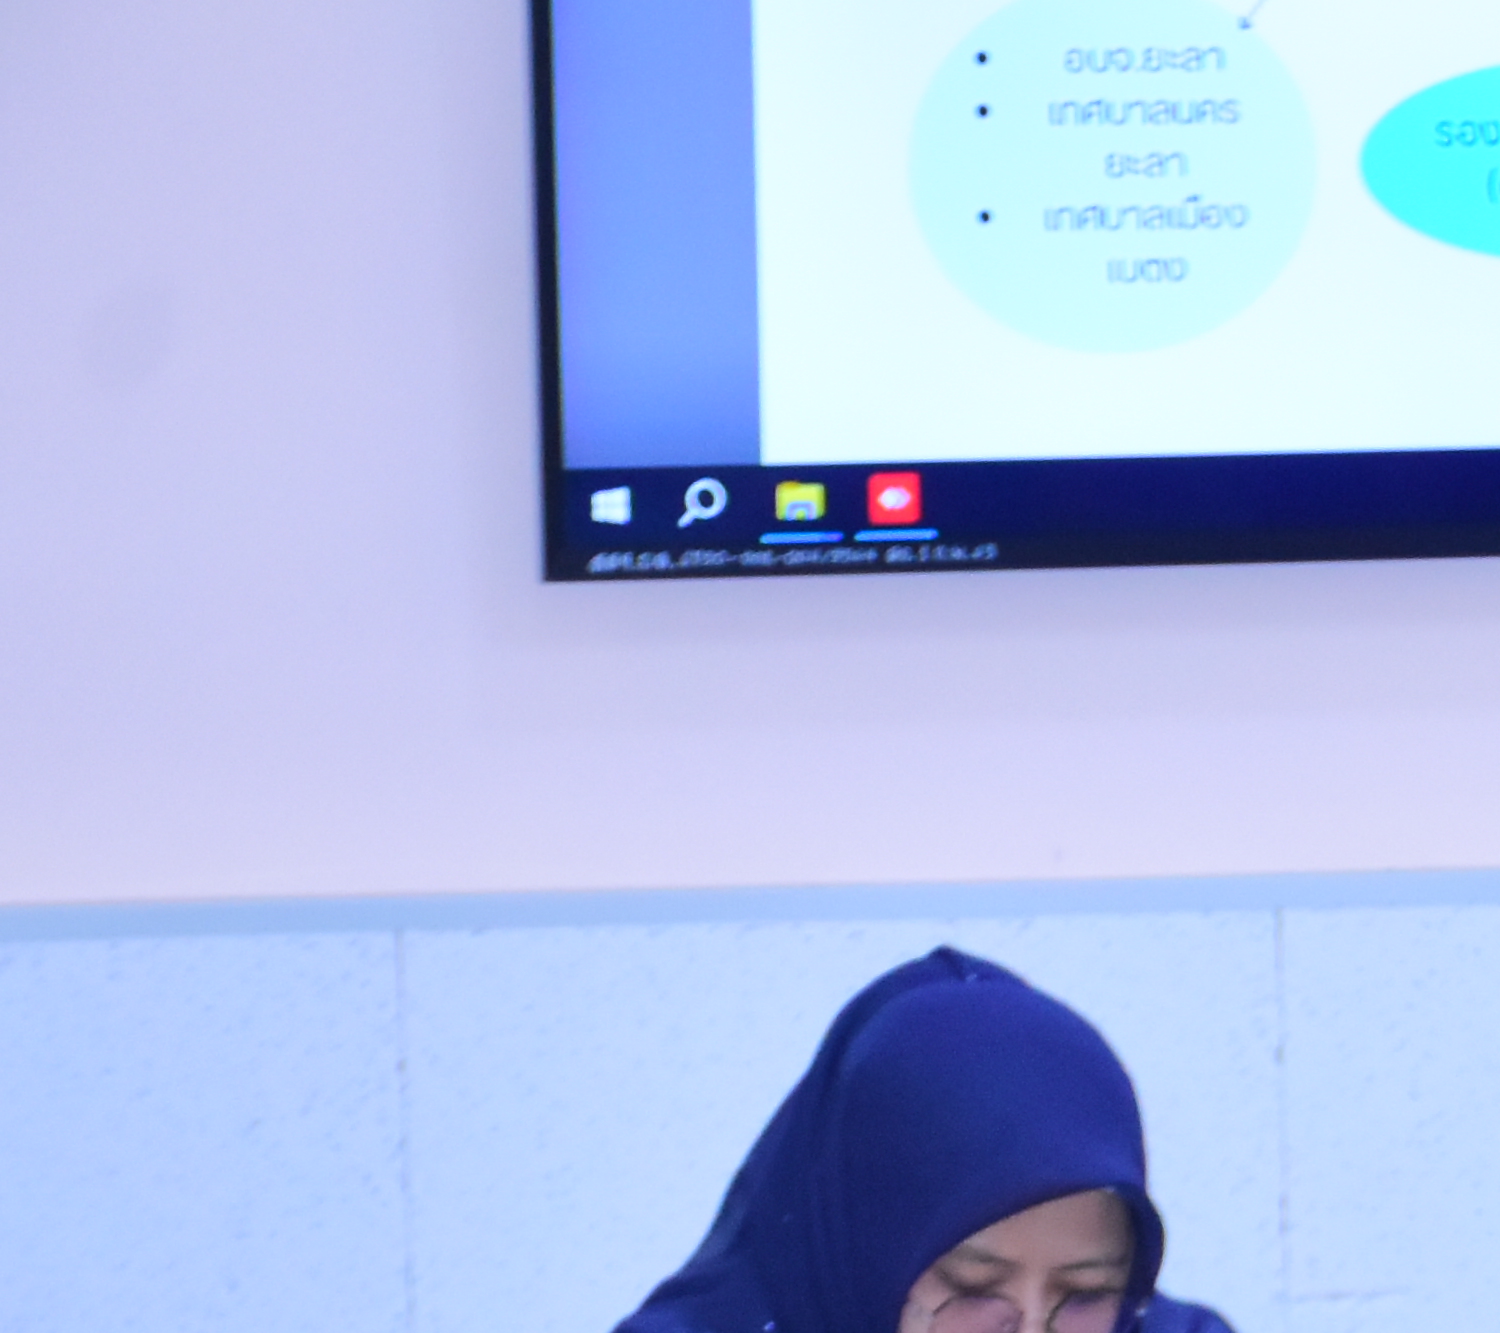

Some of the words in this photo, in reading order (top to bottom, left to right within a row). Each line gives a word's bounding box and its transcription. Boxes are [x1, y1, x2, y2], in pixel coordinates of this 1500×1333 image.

[1047, 99, 1242, 126] เทศบาลนคร
[1104, 151, 1189, 178] ยะลา
[1043, 194, 1251, 232] เทศบาลเมือง
